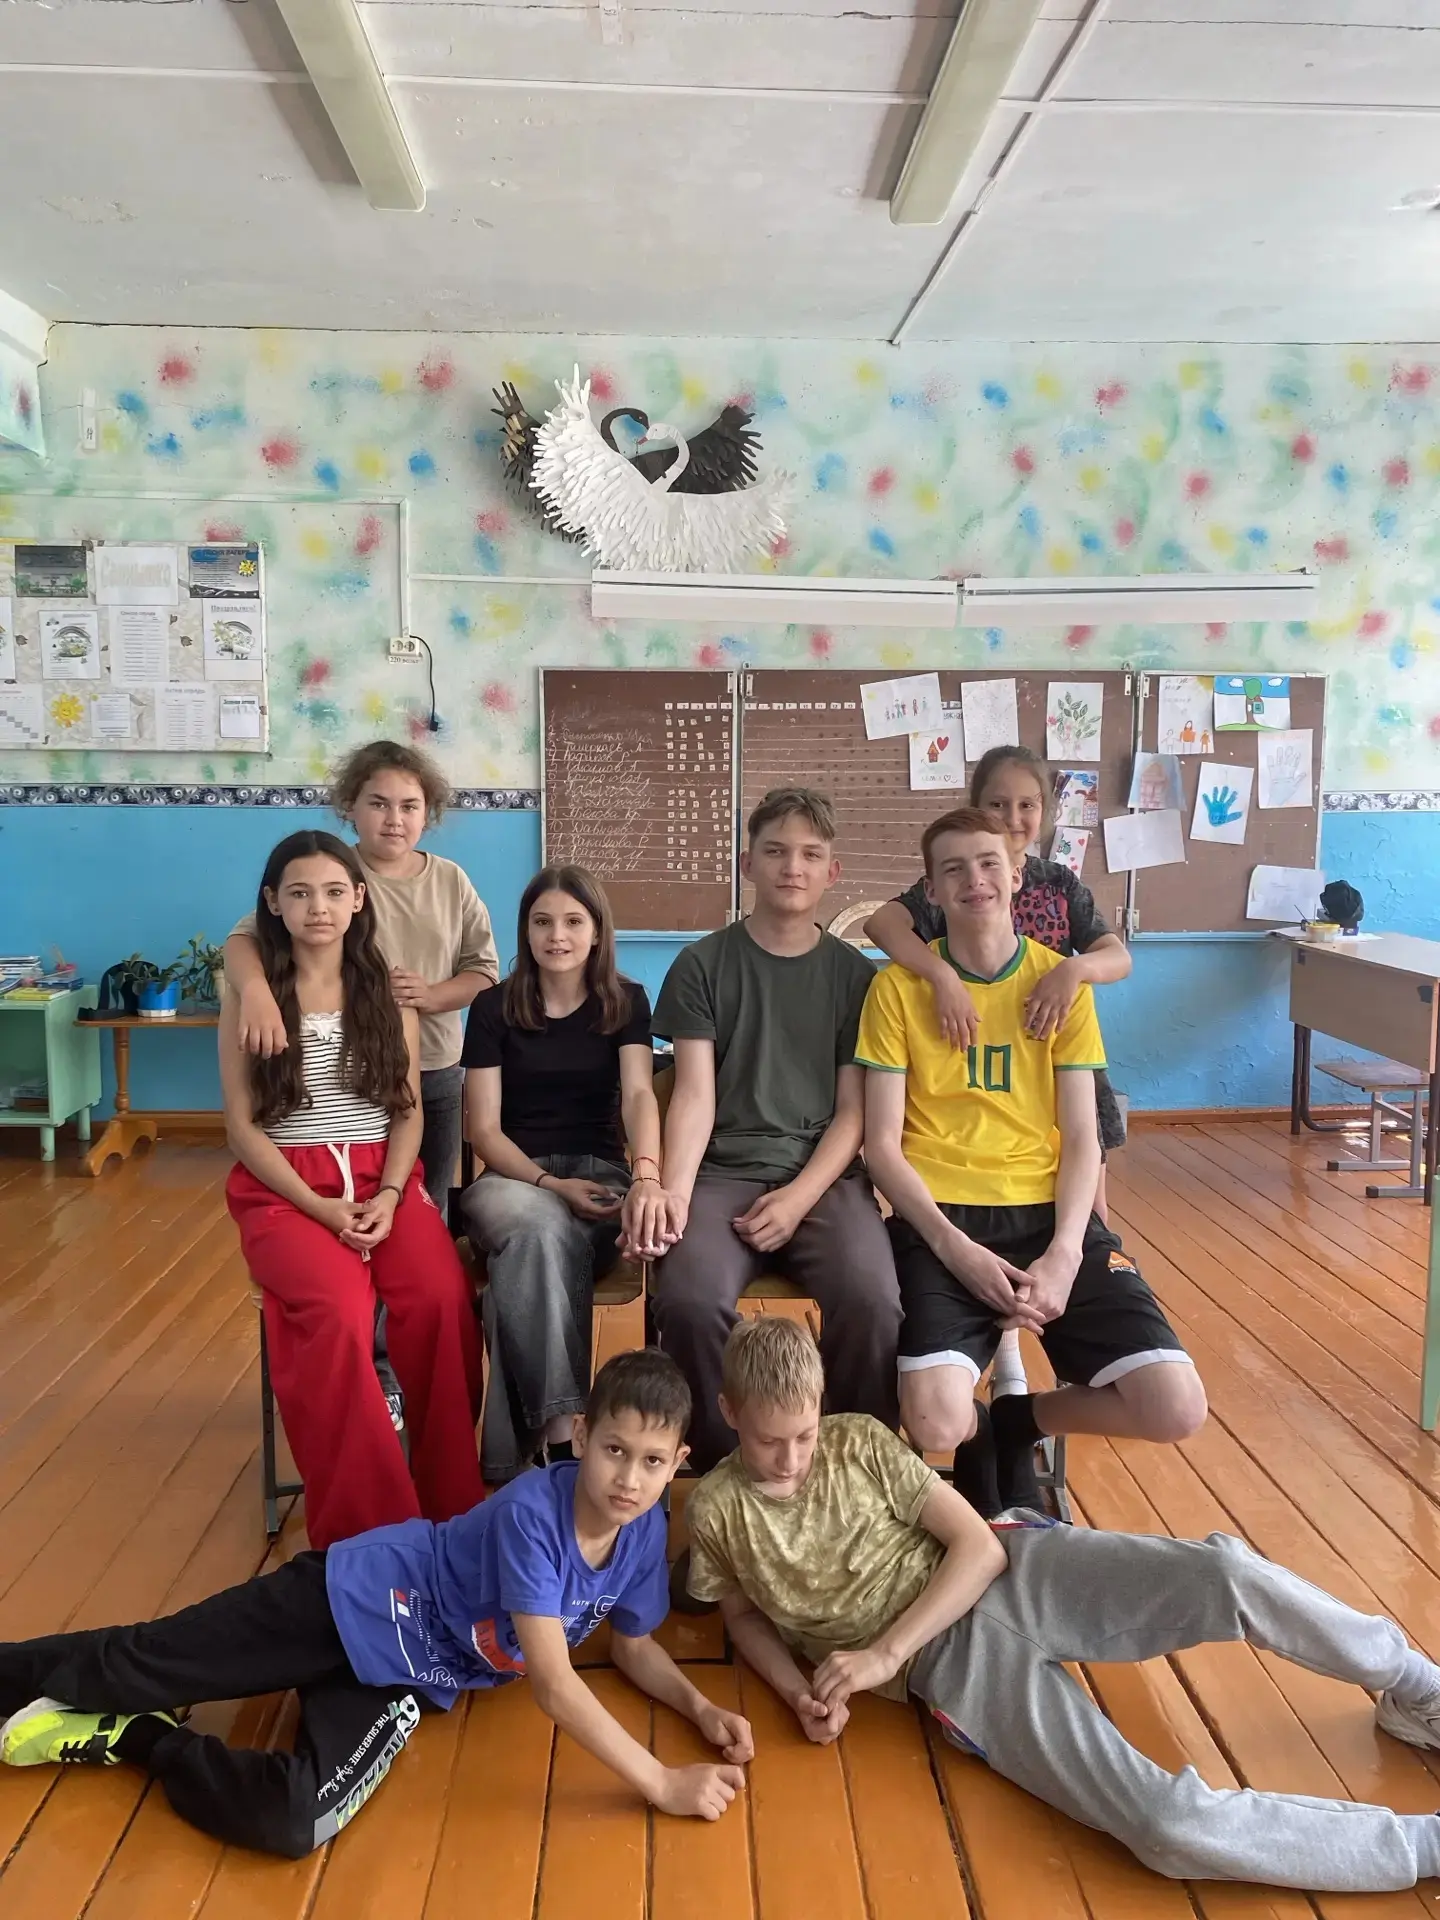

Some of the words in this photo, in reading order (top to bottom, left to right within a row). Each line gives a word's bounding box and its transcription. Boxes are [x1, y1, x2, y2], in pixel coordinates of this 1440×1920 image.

[968, 1044, 1012, 1092] 10
[374, 1713, 390, 1729] THE
[361, 1726, 380, 1748] SILVER
[348, 1745, 367, 1766] STATE
[335, 1765, 354, 1783] Style
